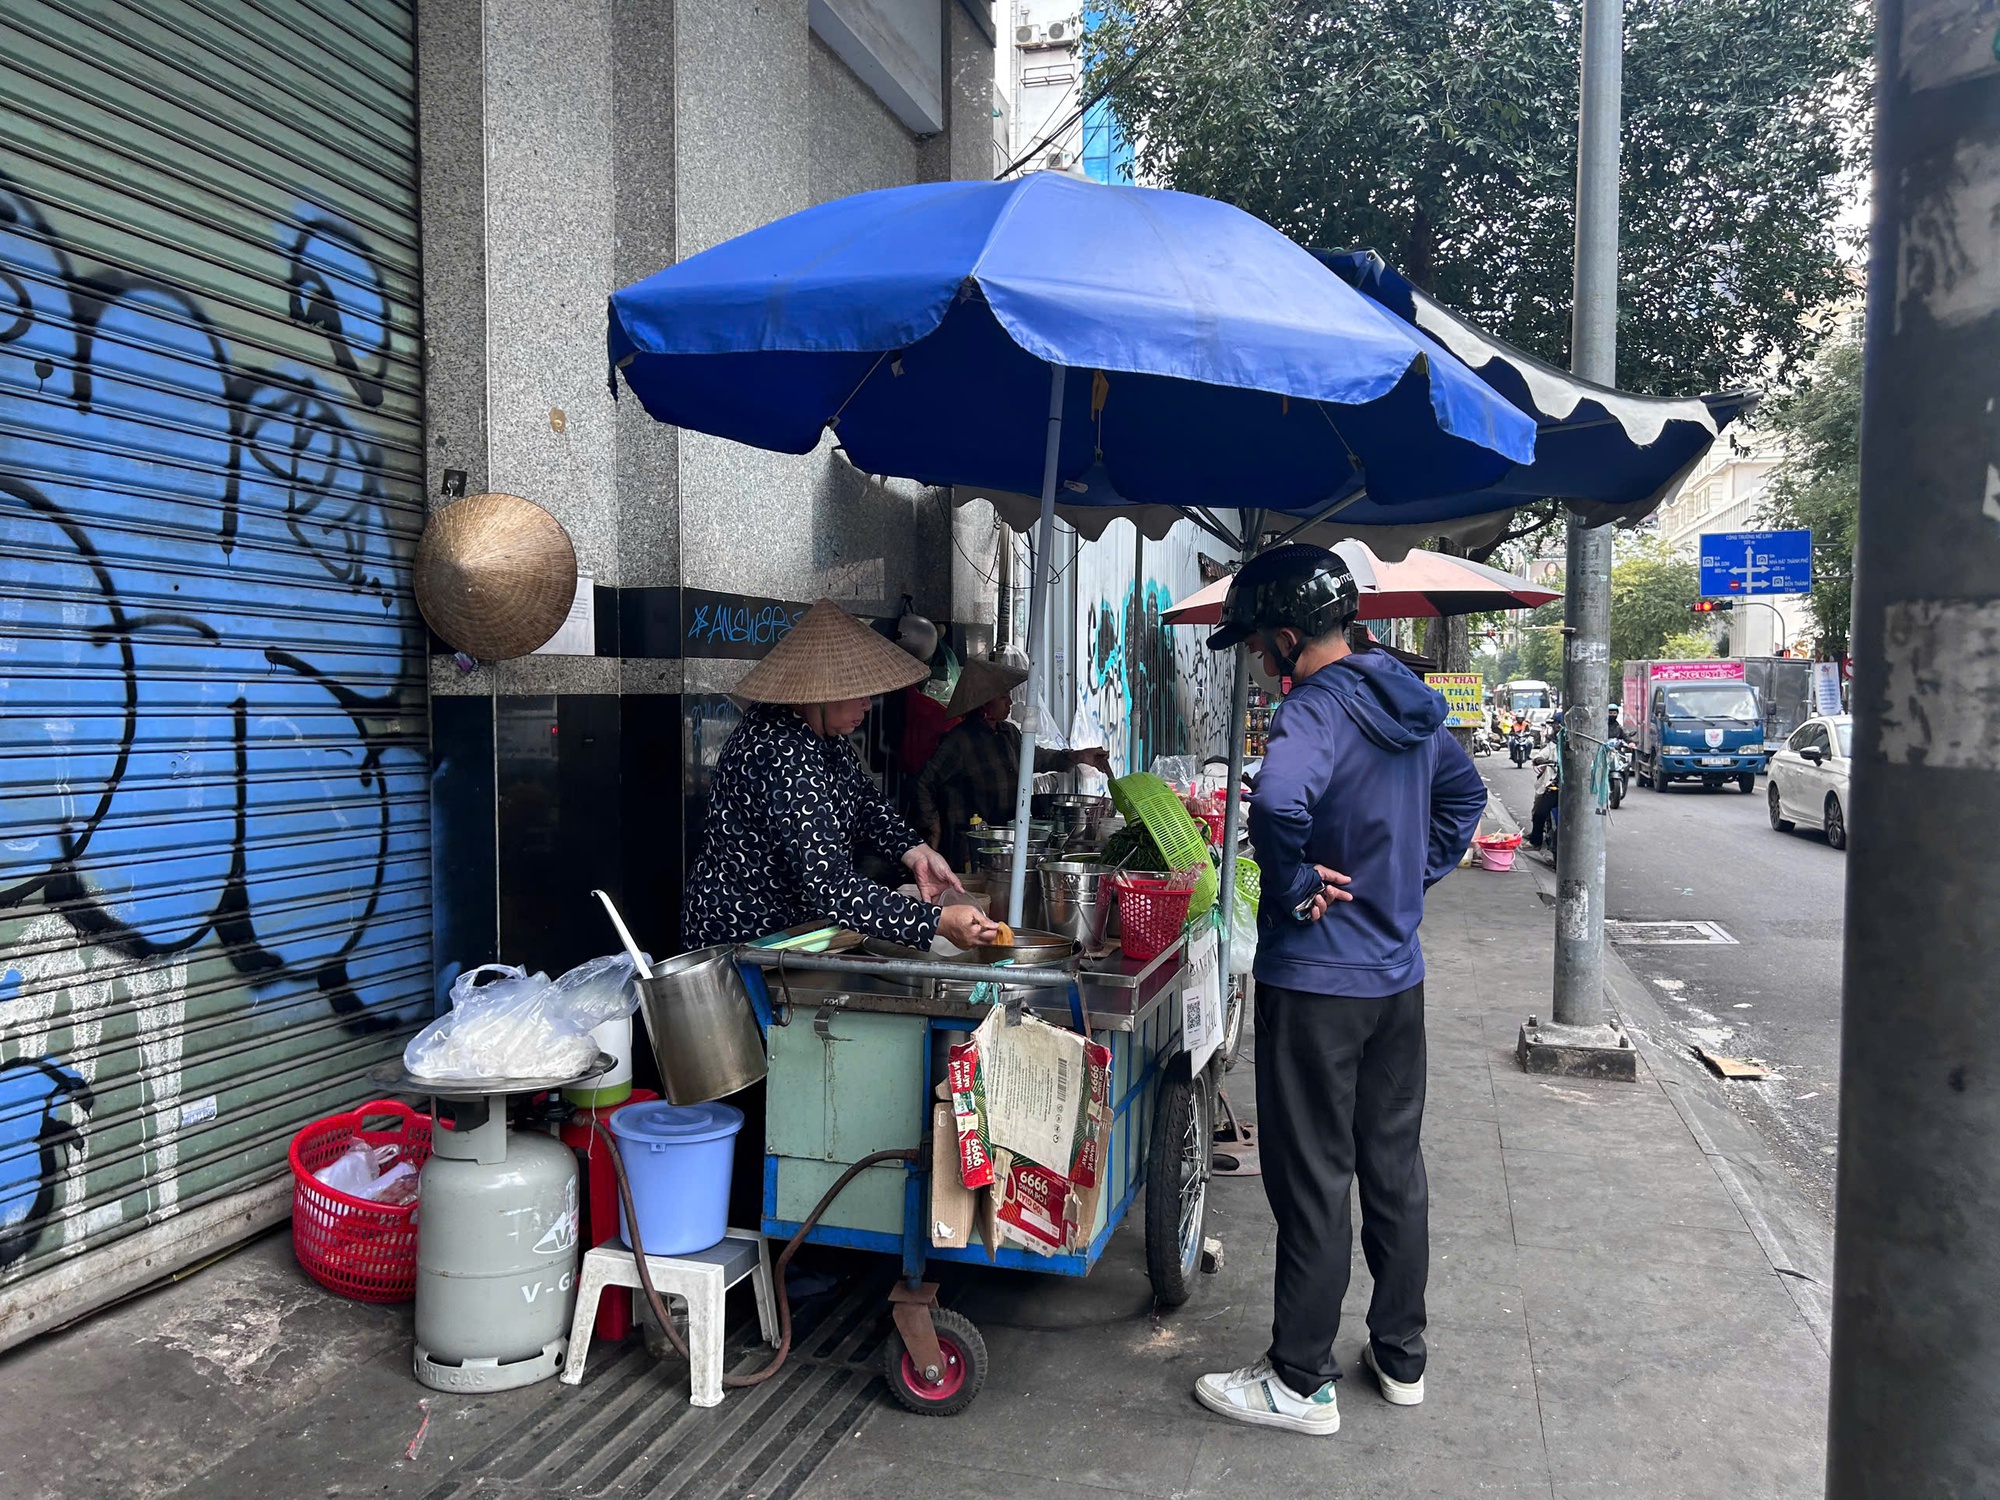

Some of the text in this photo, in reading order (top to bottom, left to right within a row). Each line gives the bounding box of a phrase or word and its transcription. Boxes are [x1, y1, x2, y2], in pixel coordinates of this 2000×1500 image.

[1447, 686, 1475, 696] THÁI
[1445, 714, 1461, 726] UỐN
[1090, 1064, 1099, 1093] 9999
[971, 1138, 985, 1168] 9999
[1020, 1171, 1048, 1195] 9999
[1262, 1383, 1273, 1406] LACOSTE
